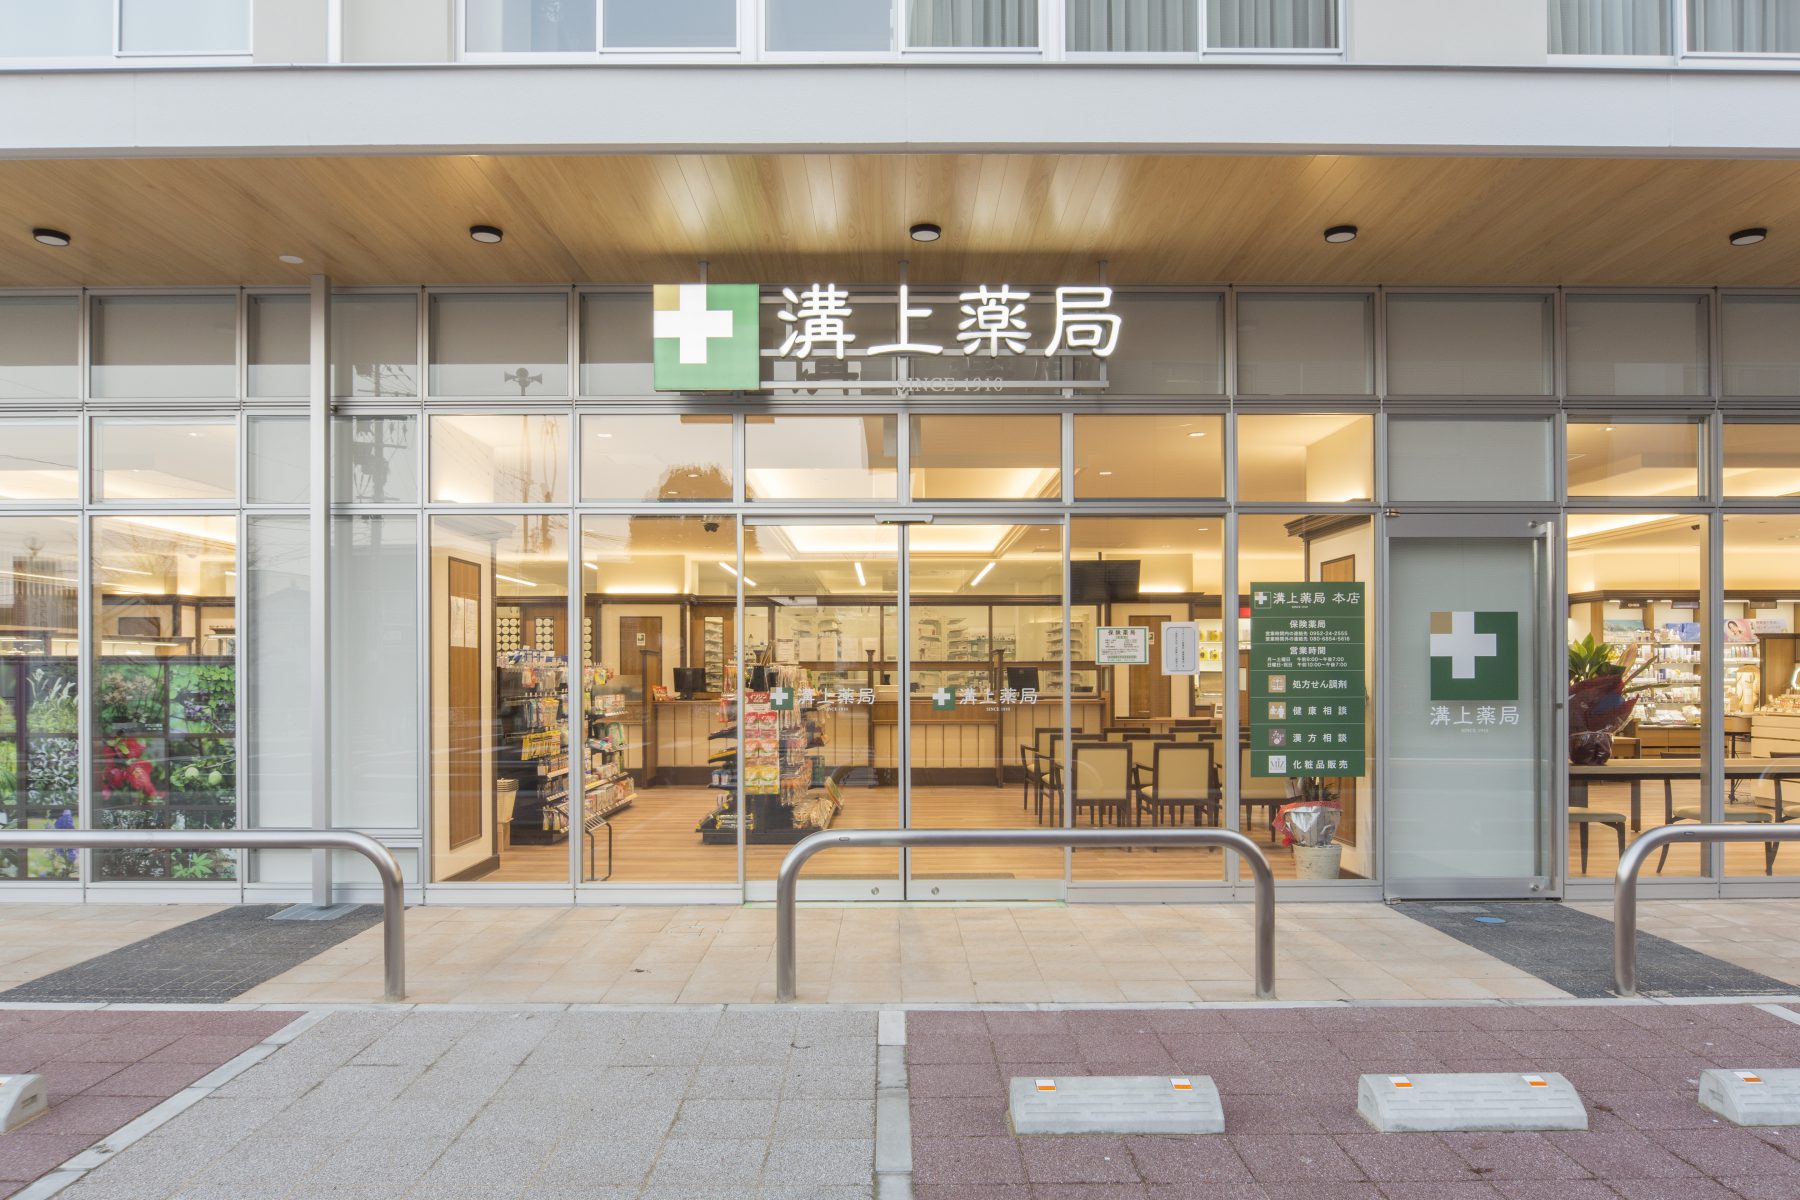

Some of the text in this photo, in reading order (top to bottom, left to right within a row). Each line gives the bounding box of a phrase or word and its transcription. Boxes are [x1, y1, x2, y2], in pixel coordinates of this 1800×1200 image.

[777, 283, 1122, 360] 溝上薬局
[1272, 591, 1361, 604] 溝上薬局 本店
[1289, 619, 1326, 629] 保険薬局
[1289, 646, 1326, 655] 営業時間
[1292, 679, 1348, 689] 処方せん調剤
[797, 687, 876, 705] 溝上薬局
[959, 687, 1038, 705] 溝上薬局
[1292, 705, 1348, 716] 健康相談
[1430, 705, 1520, 726] 溝上薬局
[1292, 733, 1348, 743] 漢方相談
[1292, 759, 1348, 770] 化粧品販売
